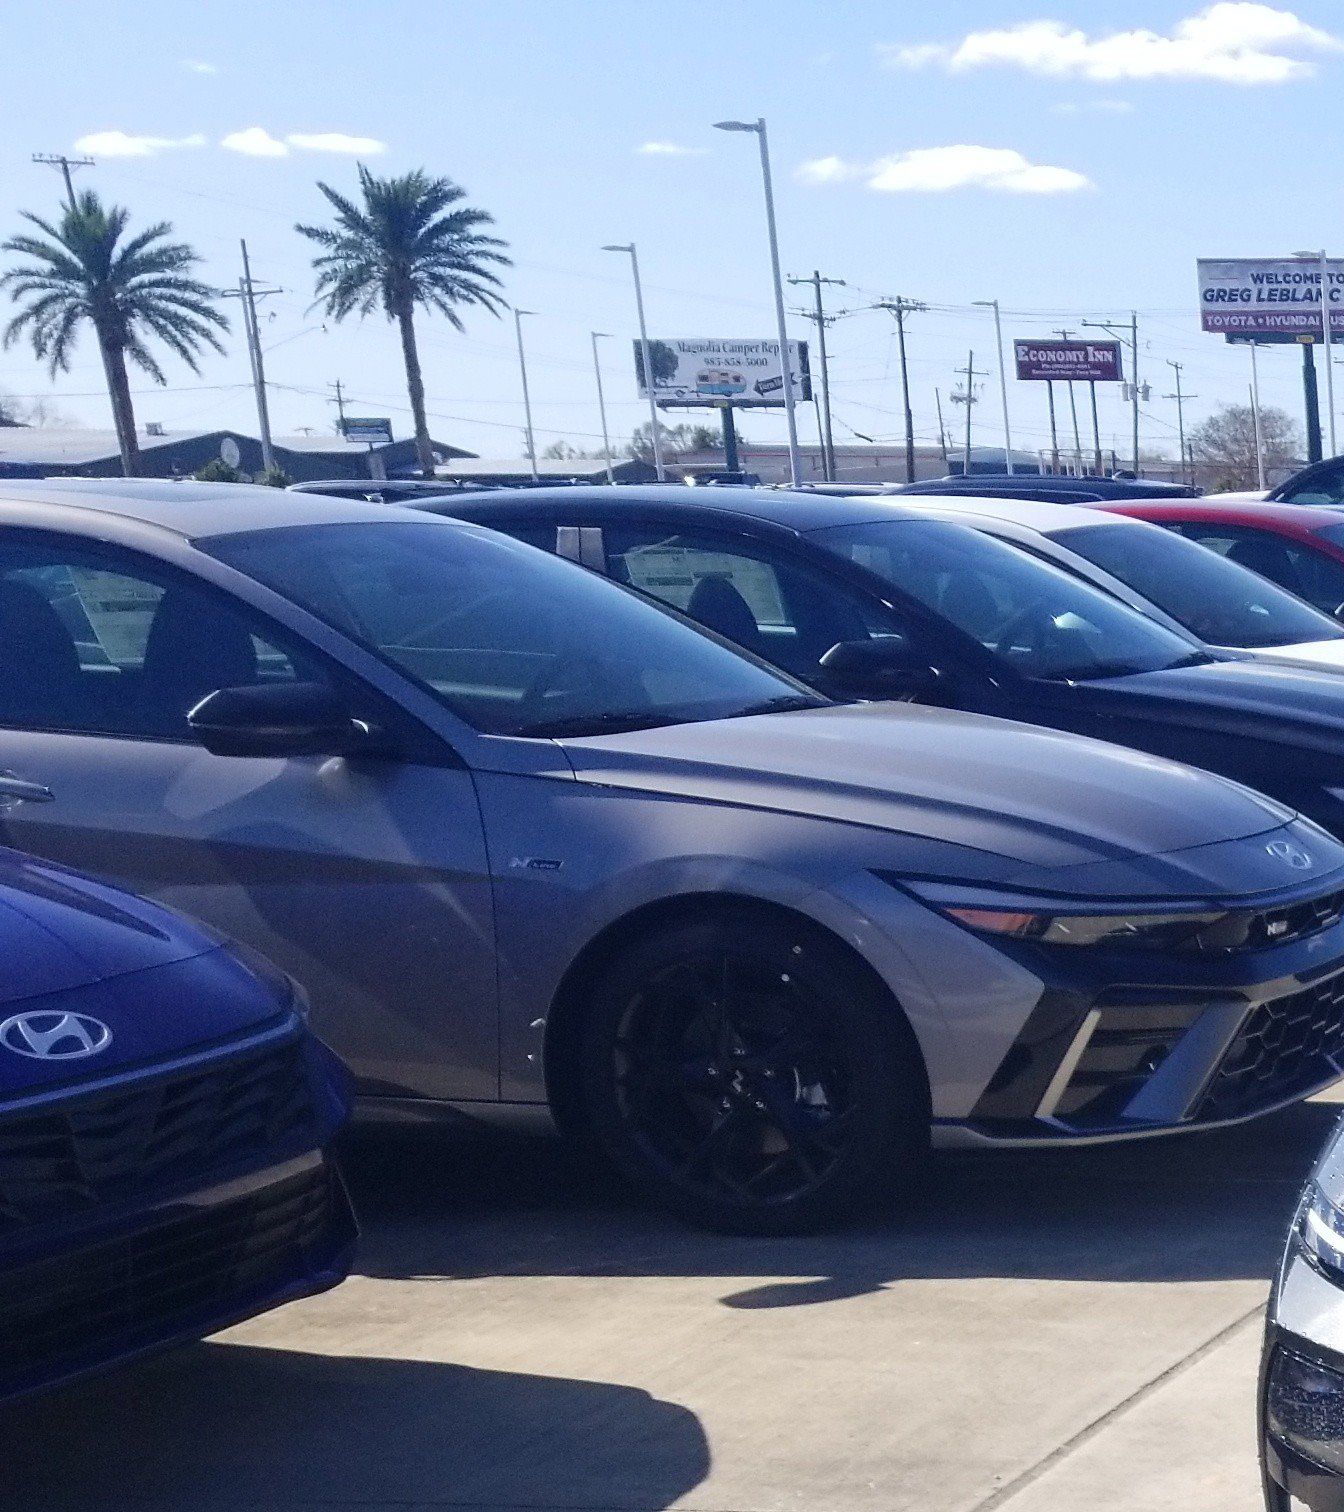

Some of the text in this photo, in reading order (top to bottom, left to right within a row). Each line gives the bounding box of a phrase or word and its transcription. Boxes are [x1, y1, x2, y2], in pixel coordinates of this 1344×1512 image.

[1250, 272, 1322, 284] WELCOME
[1202, 287, 1252, 303] GREG
[1206, 315, 1256, 326] TOYOTA
[1265, 315, 1320, 326] HYUNDAI
[677, 340, 793, 357] Magnolia Camper Repr
